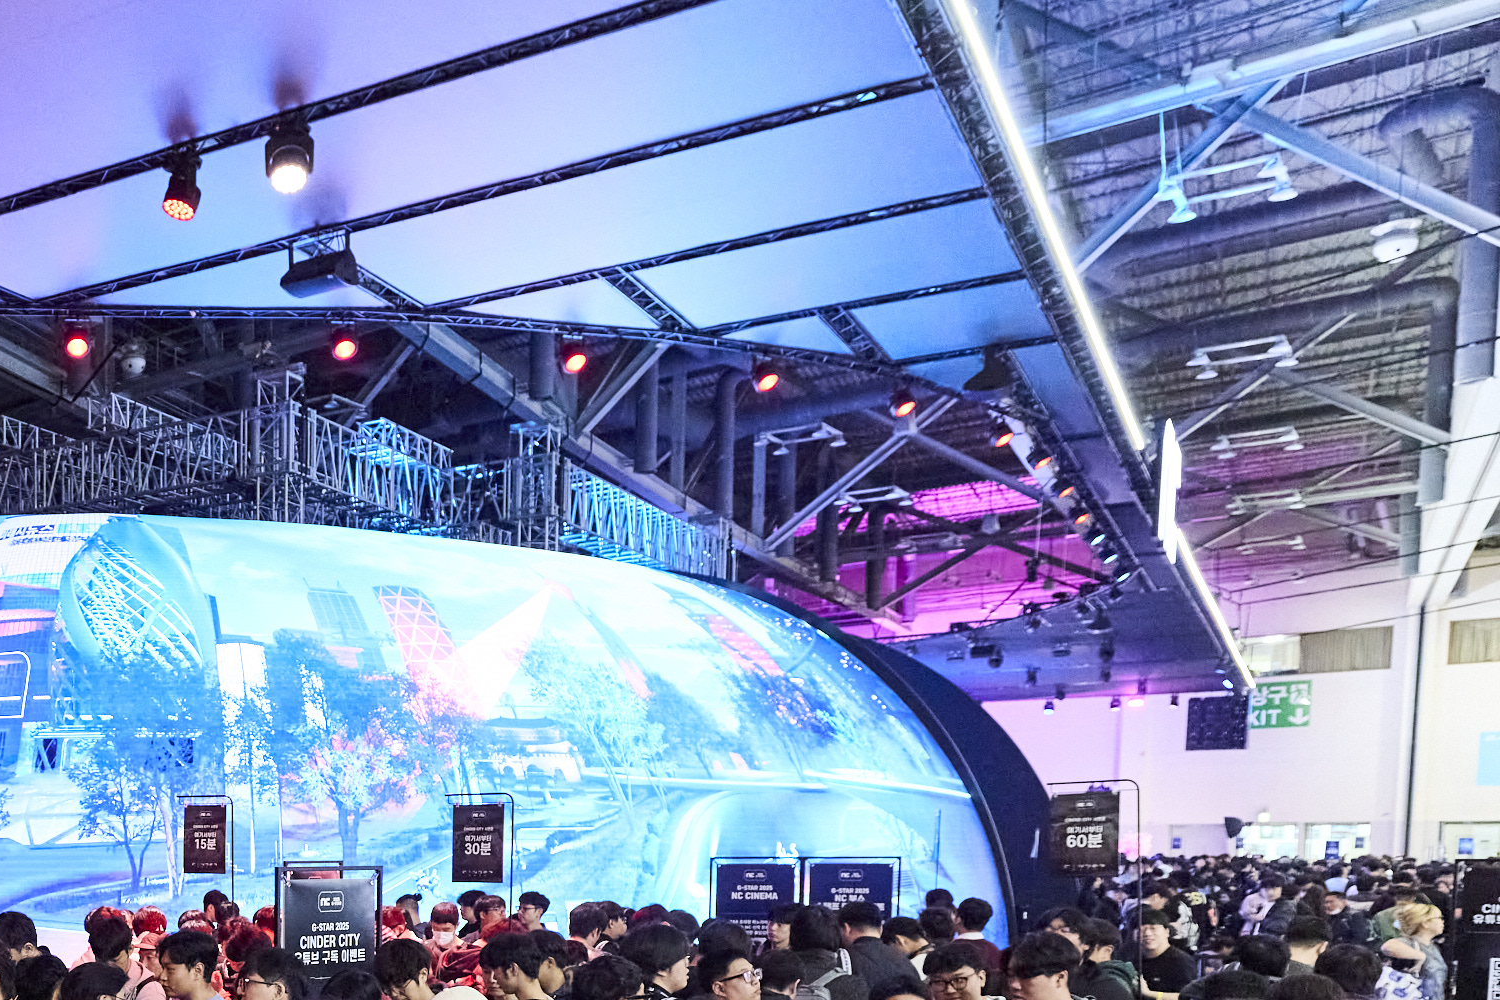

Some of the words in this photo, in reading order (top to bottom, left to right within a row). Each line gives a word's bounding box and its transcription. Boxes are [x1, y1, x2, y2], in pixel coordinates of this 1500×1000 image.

[1249, 709, 1281, 726] XIT
[1066, 826, 1103, 834] 여기서부터
[194, 838, 216, 850] 15분
[1066, 833, 1103, 848] 60분
[464, 842, 491, 856] 30분
[731, 892, 744, 900] NC
[745, 892, 778, 900] CINEMA
[834, 894, 847, 902] NC
[312, 922, 334, 932] G-STAR
[335, 922, 350, 931] 2025
[300, 934, 336, 950] CINDER
[338, 933, 361, 947] CITY
[322, 950, 338, 965] 구독
[341, 948, 366, 963] 이벤트
